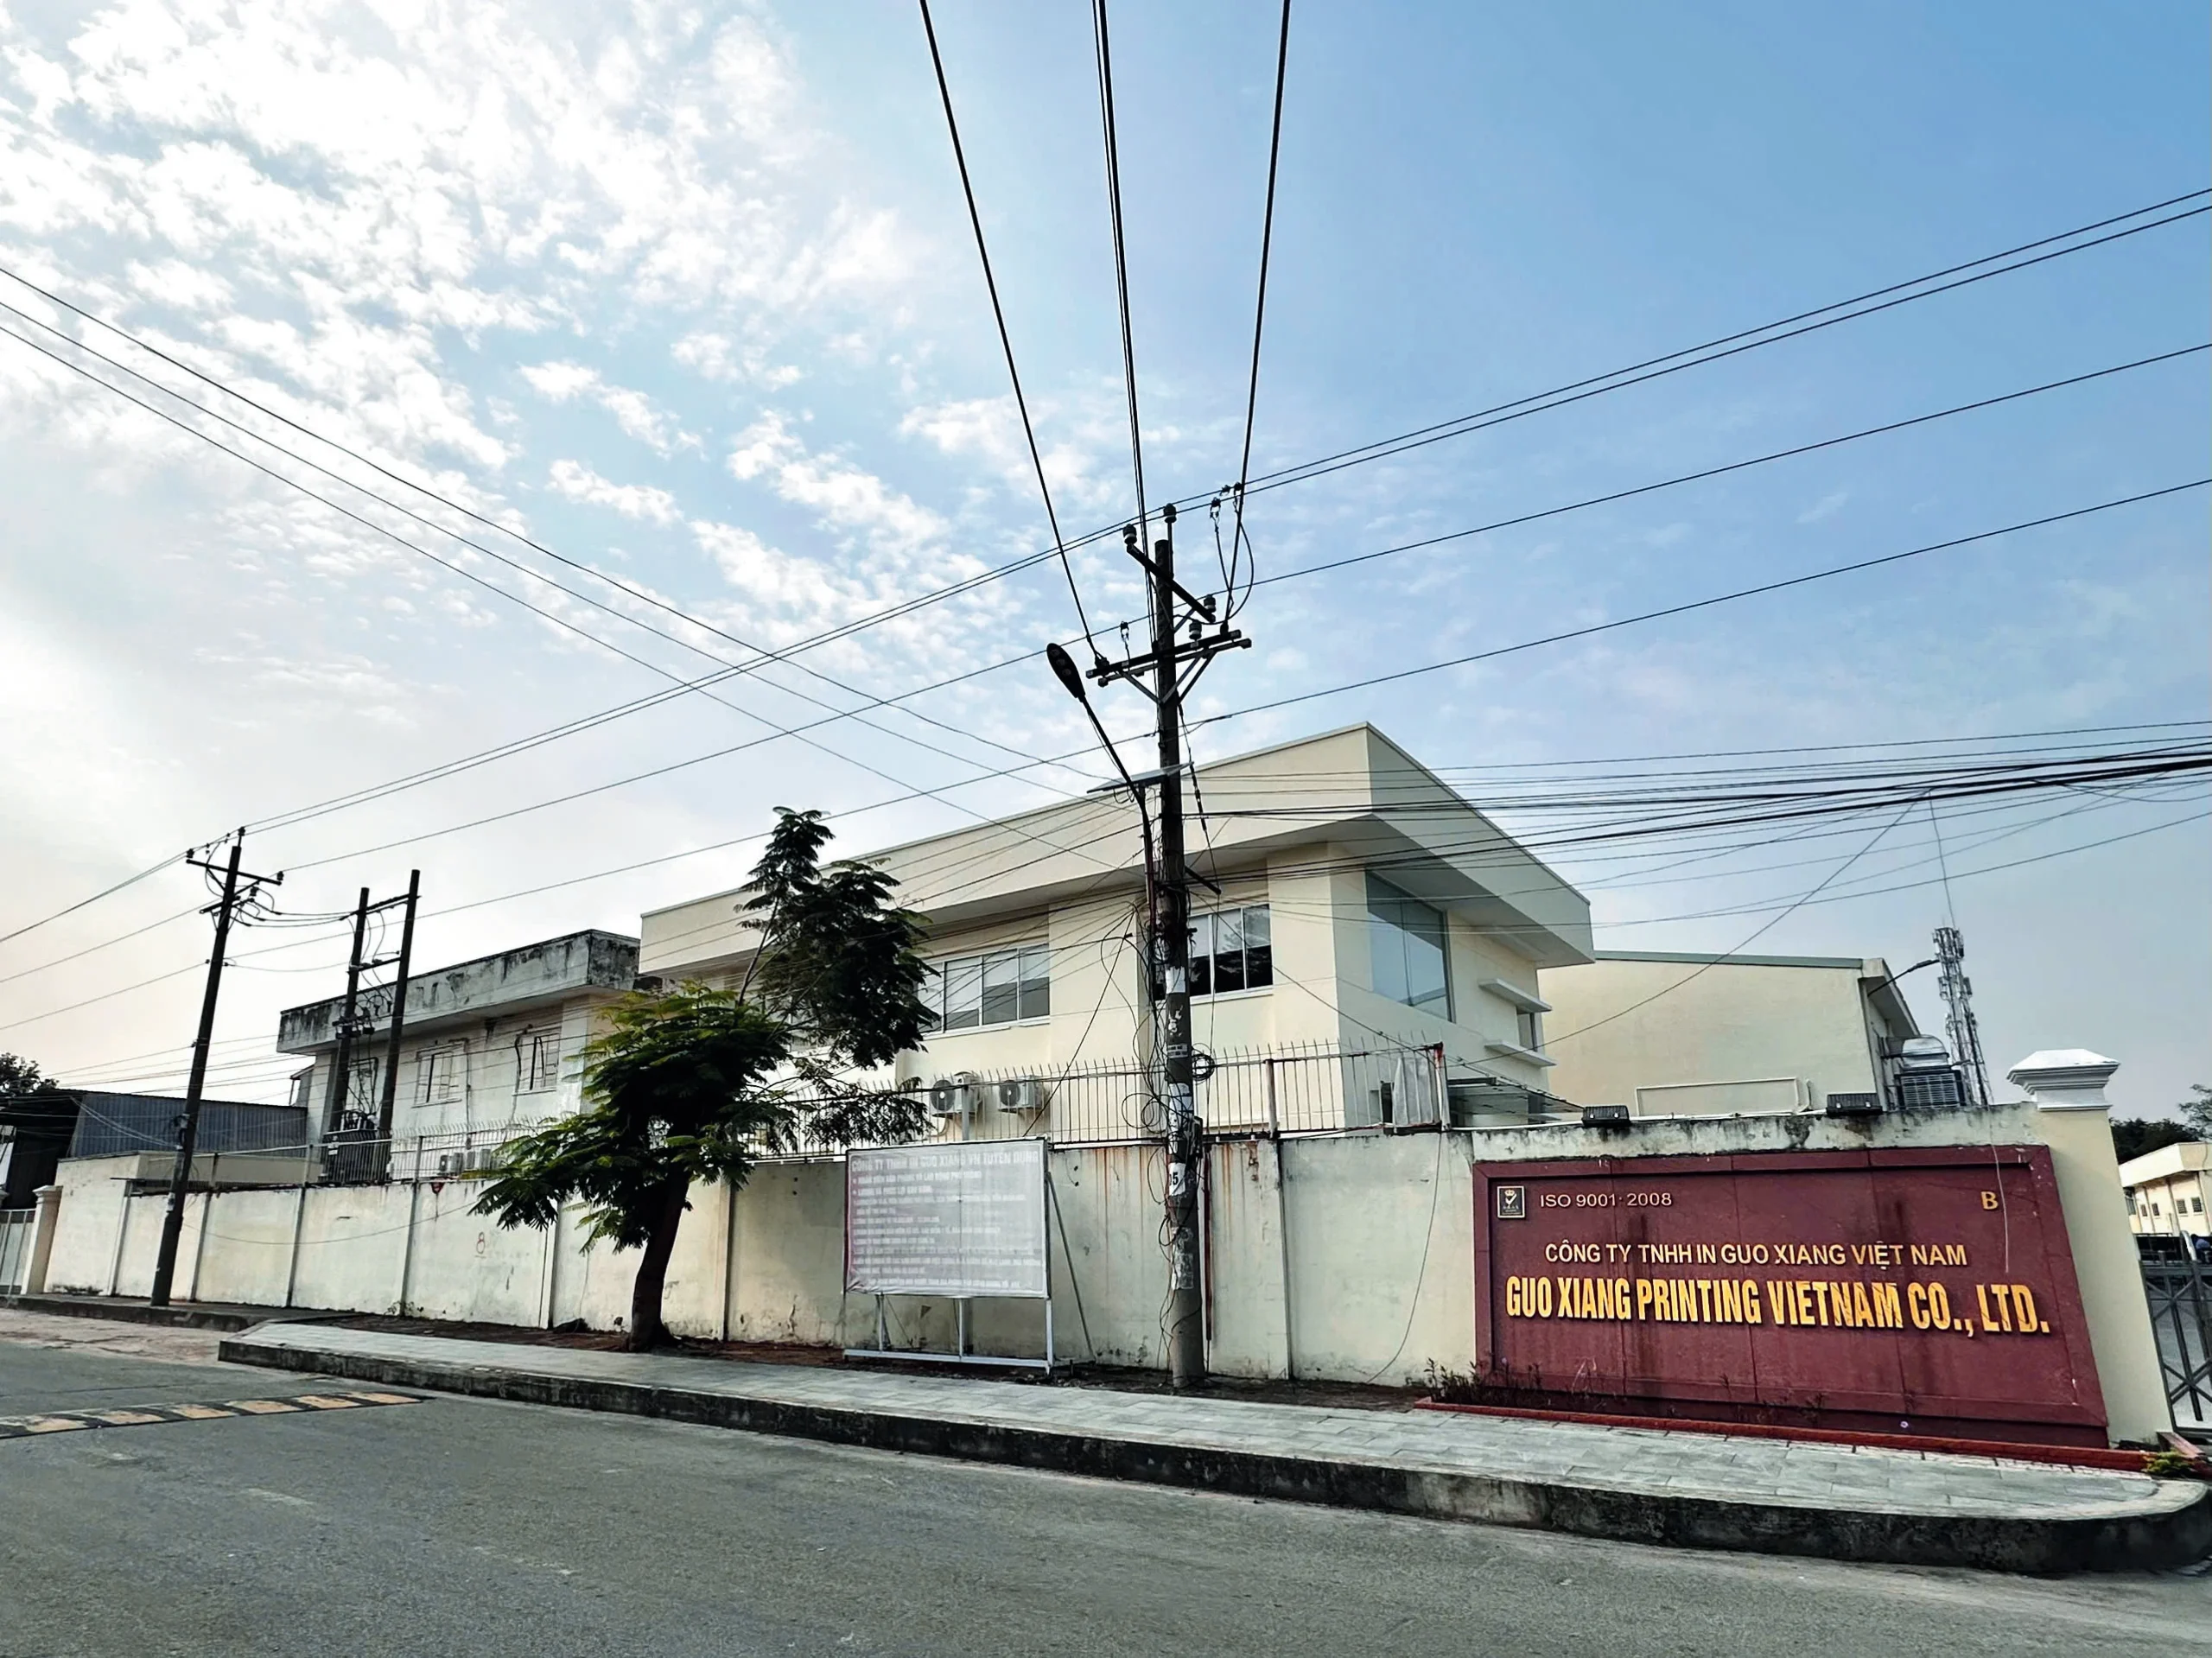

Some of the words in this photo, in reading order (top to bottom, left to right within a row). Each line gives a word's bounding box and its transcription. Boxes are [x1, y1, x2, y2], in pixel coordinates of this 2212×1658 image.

[1541, 1193, 1572, 1208] ISO
[1980, 1191, 1999, 1210] B
[1545, 1239, 1601, 1263] CÔNG
[1605, 1244, 1631, 1263] TY
[1638, 1244, 1693, 1264] TNHH
[1696, 1244, 1717, 1264] IN
[1720, 1243, 1770, 1264] GUO
[1773, 1244, 1847, 1265] XIANG
[1851, 1240, 1904, 1270] VIỆT
[1910, 1244, 1968, 1266] NAM
[1505, 1275, 1553, 1318] GUO
[1556, 1277, 1632, 1320] XIANG
[1636, 1278, 1763, 1324] PRINTING
[1766, 1280, 1904, 1329] VIETNAM
[1907, 1281, 1974, 1337] CO.,
[1975, 1283, 2050, 1333] LTD.
